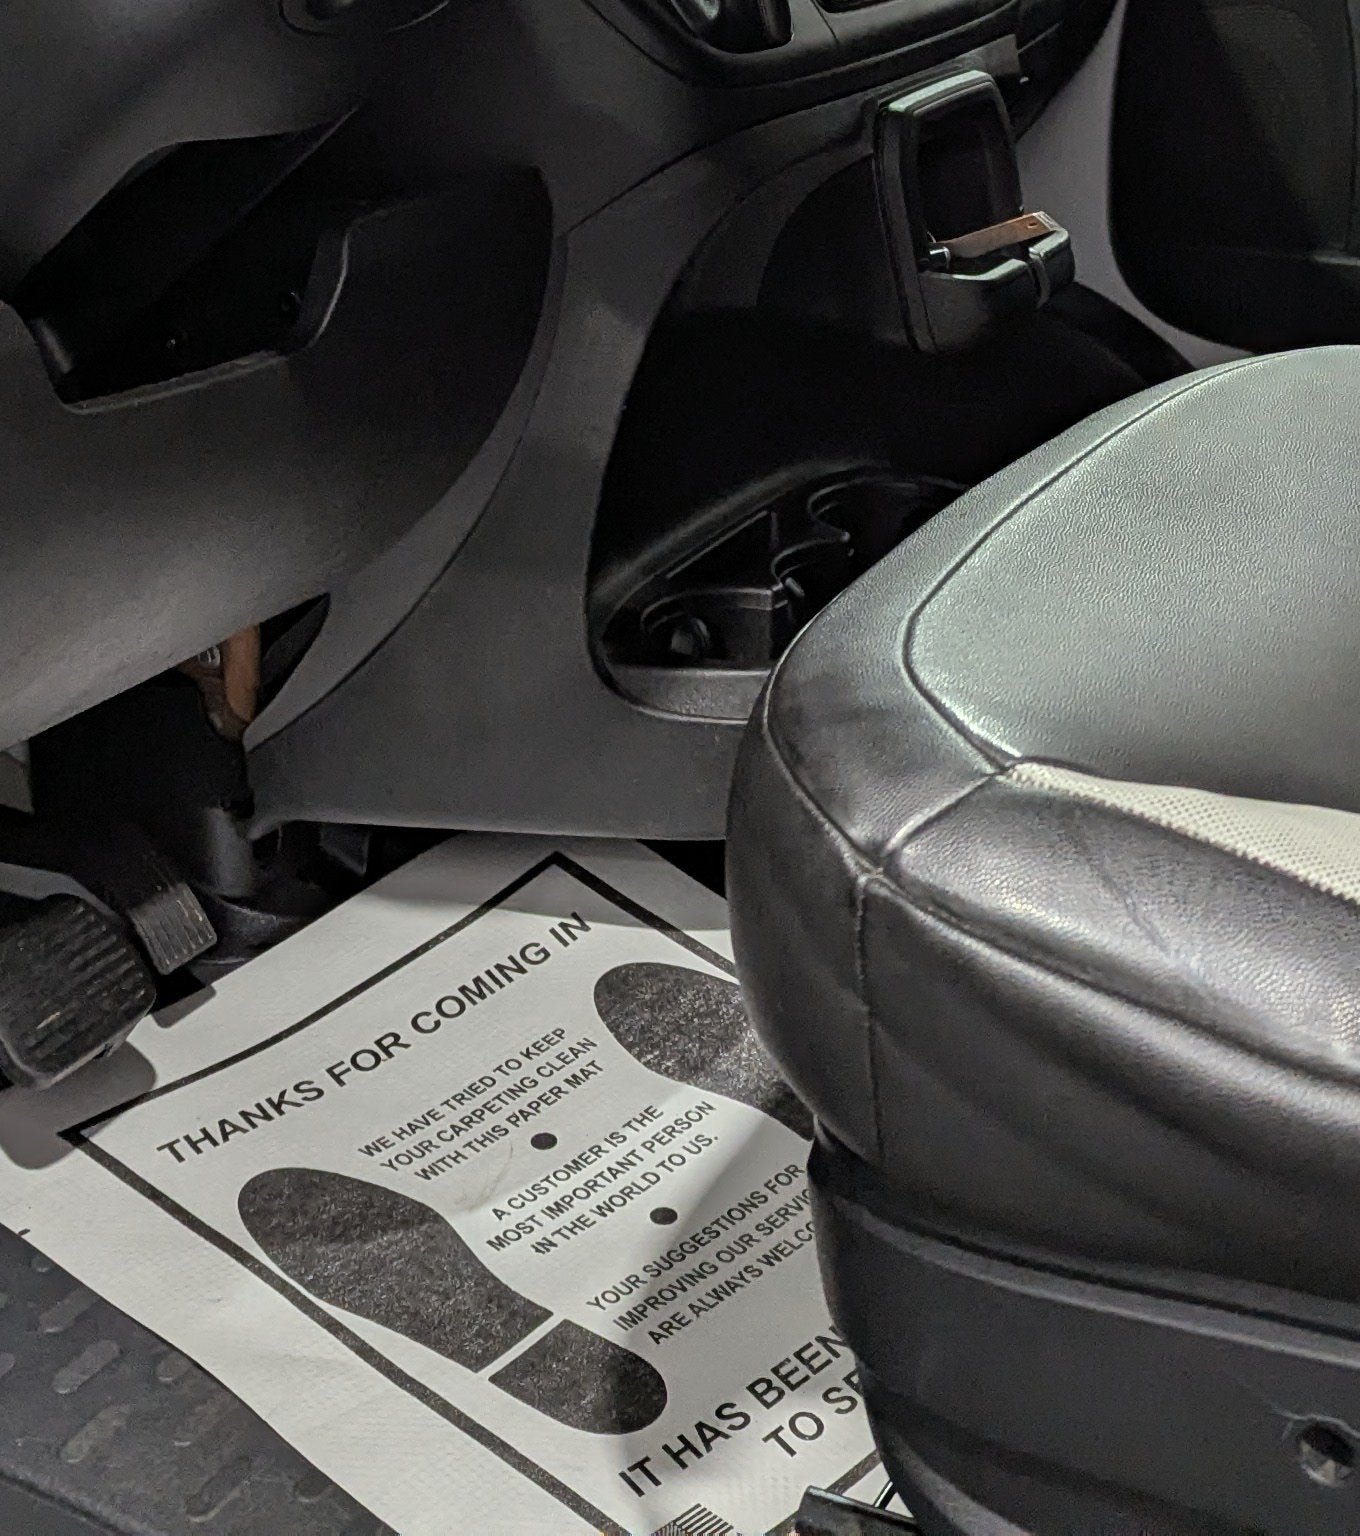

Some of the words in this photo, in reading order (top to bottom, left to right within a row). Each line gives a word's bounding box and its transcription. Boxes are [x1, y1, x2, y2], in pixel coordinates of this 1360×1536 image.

[157, 1080, 325, 1163] THANKS
[325, 1032, 411, 1087] FOR
[410, 942, 551, 1033] COMING
[548, 911, 592, 947] IN
[358, 1135, 396, 1157] WE
[392, 1108, 444, 1141] HAVE
[440, 1075, 497, 1111] TRIED
[493, 1058, 522, 1076] TO
[520, 1027, 566, 1061] KEEP
[380, 1139, 439, 1172] YOUR
[436, 1076, 539, 1142] CARPETING
[536, 1037, 597, 1078] CLEAN
[414, 1150, 469, 1181] WITH
[462, 1124, 510, 1154] THIS
[505, 1085, 569, 1128] PAPER
[563, 1060, 604, 1089] MAT
[492, 1207, 511, 1221] A
[507, 1144, 609, 1210] CUSTOMER
[604, 1131, 628, 1149] IS
[622, 1104, 664, 1133] THE
[486, 1214, 544, 1252] MOST
[540, 1149, 645, 1221] IMPORTANT
[641, 1101, 717, 1154] PERSON
[530, 1236, 559, 1255] IN
[551, 1213, 597, 1241] THE
[589, 1171, 661, 1218] WORLD
[655, 1153, 687, 1174] TO
[682, 1133, 719, 1155] US.
[586, 1273, 648, 1312] YOUR
[642, 1190, 769, 1278] SUGGESTIONS
[764, 1164, 805, 1195] FOR
[613, 1261, 719, 1331] IMPROVING
[715, 1232, 761, 1264] OUR
[754, 1188, 812, 1236] SERVIC
[647, 1311, 693, 1345] ARE
[687, 1264, 763, 1318] ALWAYS
[756, 1221, 816, 1266] WELCO
[618, 1455, 662, 1497] IT
[662, 1402, 751, 1470] HAS
[745, 1326, 850, 1409] BEEN
[762, 1411, 825, 1457] TO
